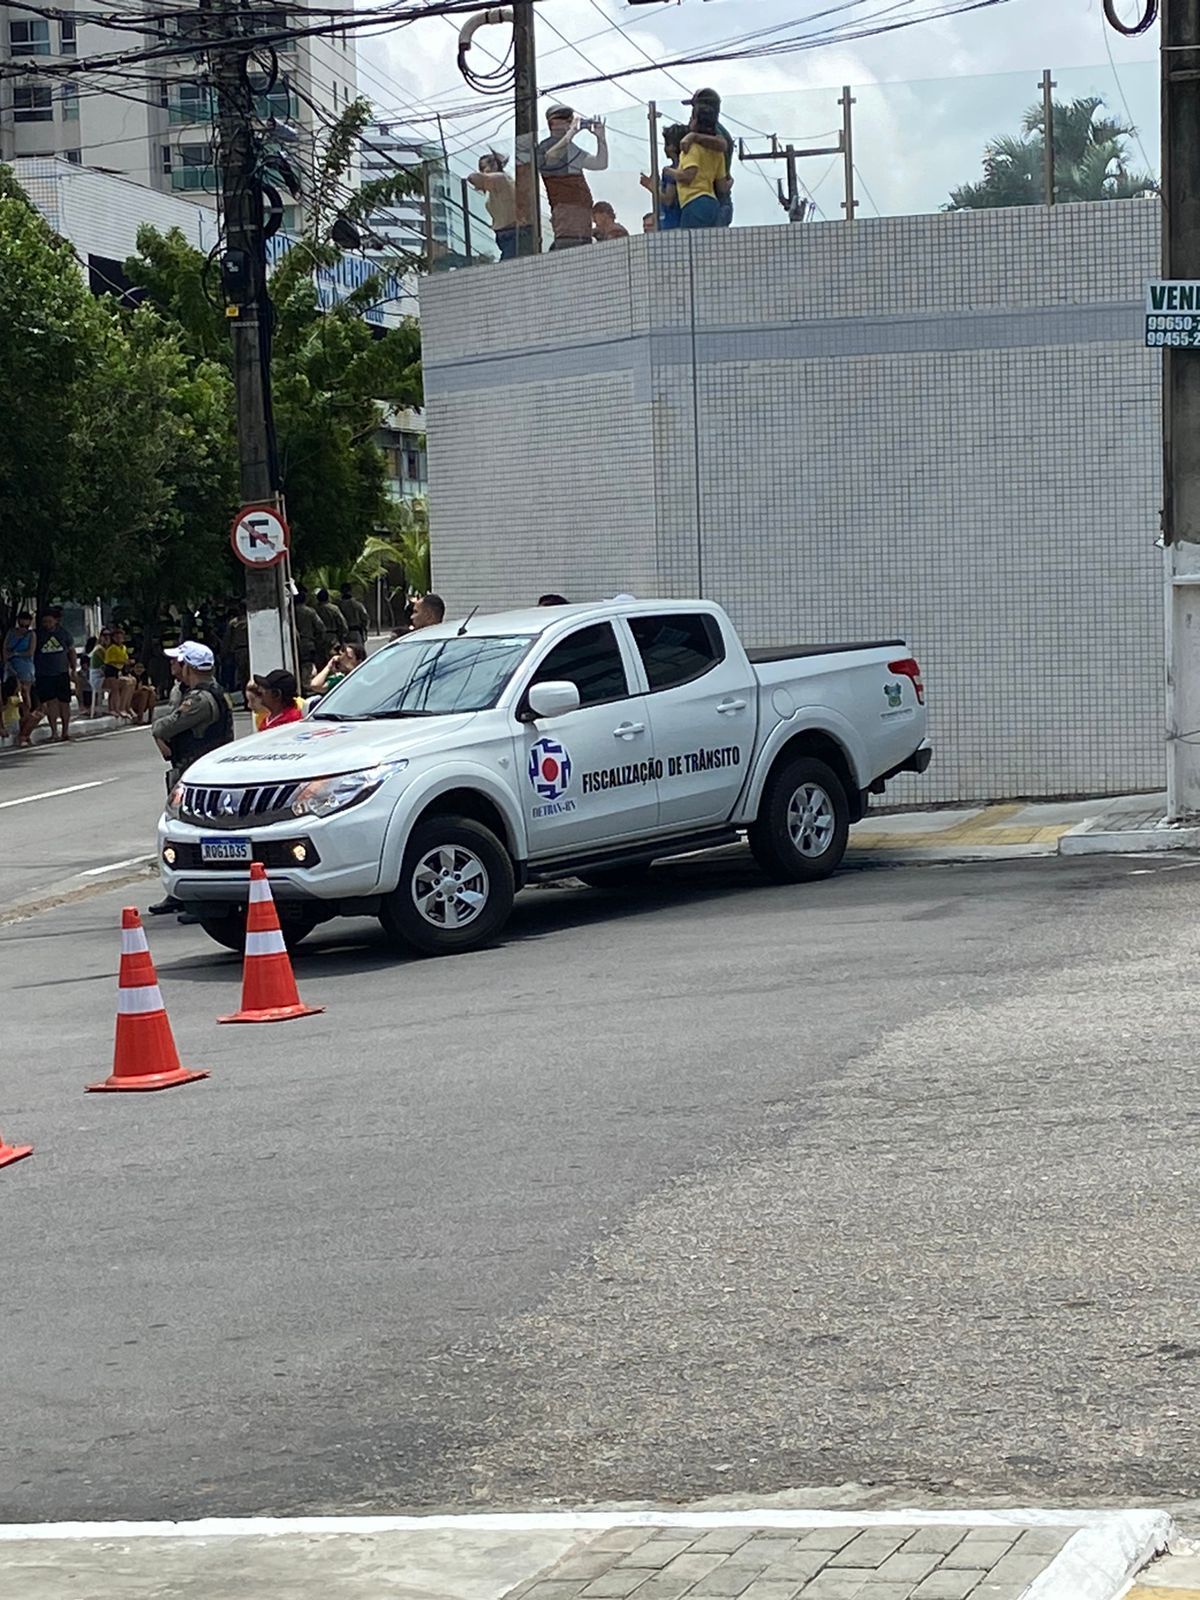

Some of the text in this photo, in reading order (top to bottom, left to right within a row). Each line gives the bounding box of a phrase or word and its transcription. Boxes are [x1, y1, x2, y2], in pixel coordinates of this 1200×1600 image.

[582, 746, 741, 793] FISCALIZAÇÃO DE TRÂNSITO
